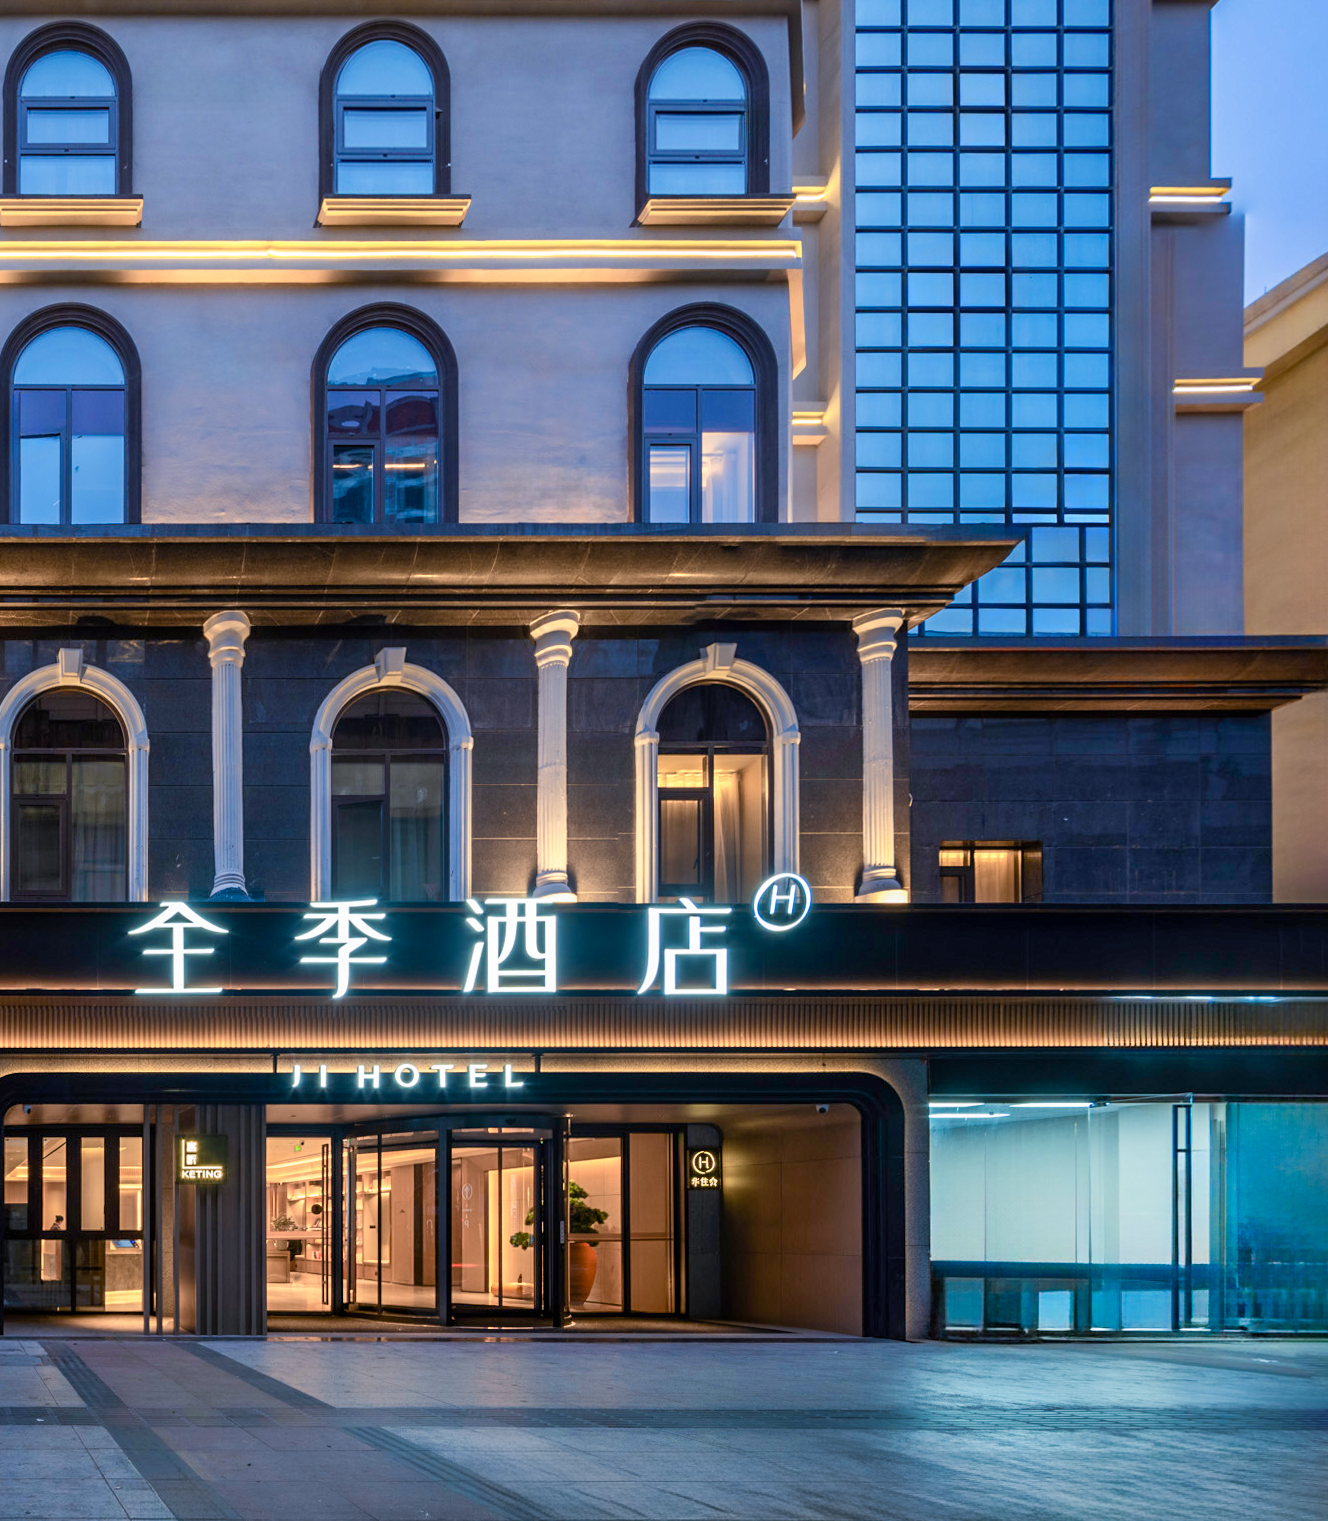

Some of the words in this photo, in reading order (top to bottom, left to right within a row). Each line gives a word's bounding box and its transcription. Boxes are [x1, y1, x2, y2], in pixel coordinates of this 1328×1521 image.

[127, 897, 733, 999] 全季酒店
[291, 1064, 327, 1089] JI
[357, 1063, 525, 1089] HOTEL
[181, 1169, 223, 1179] KETING
